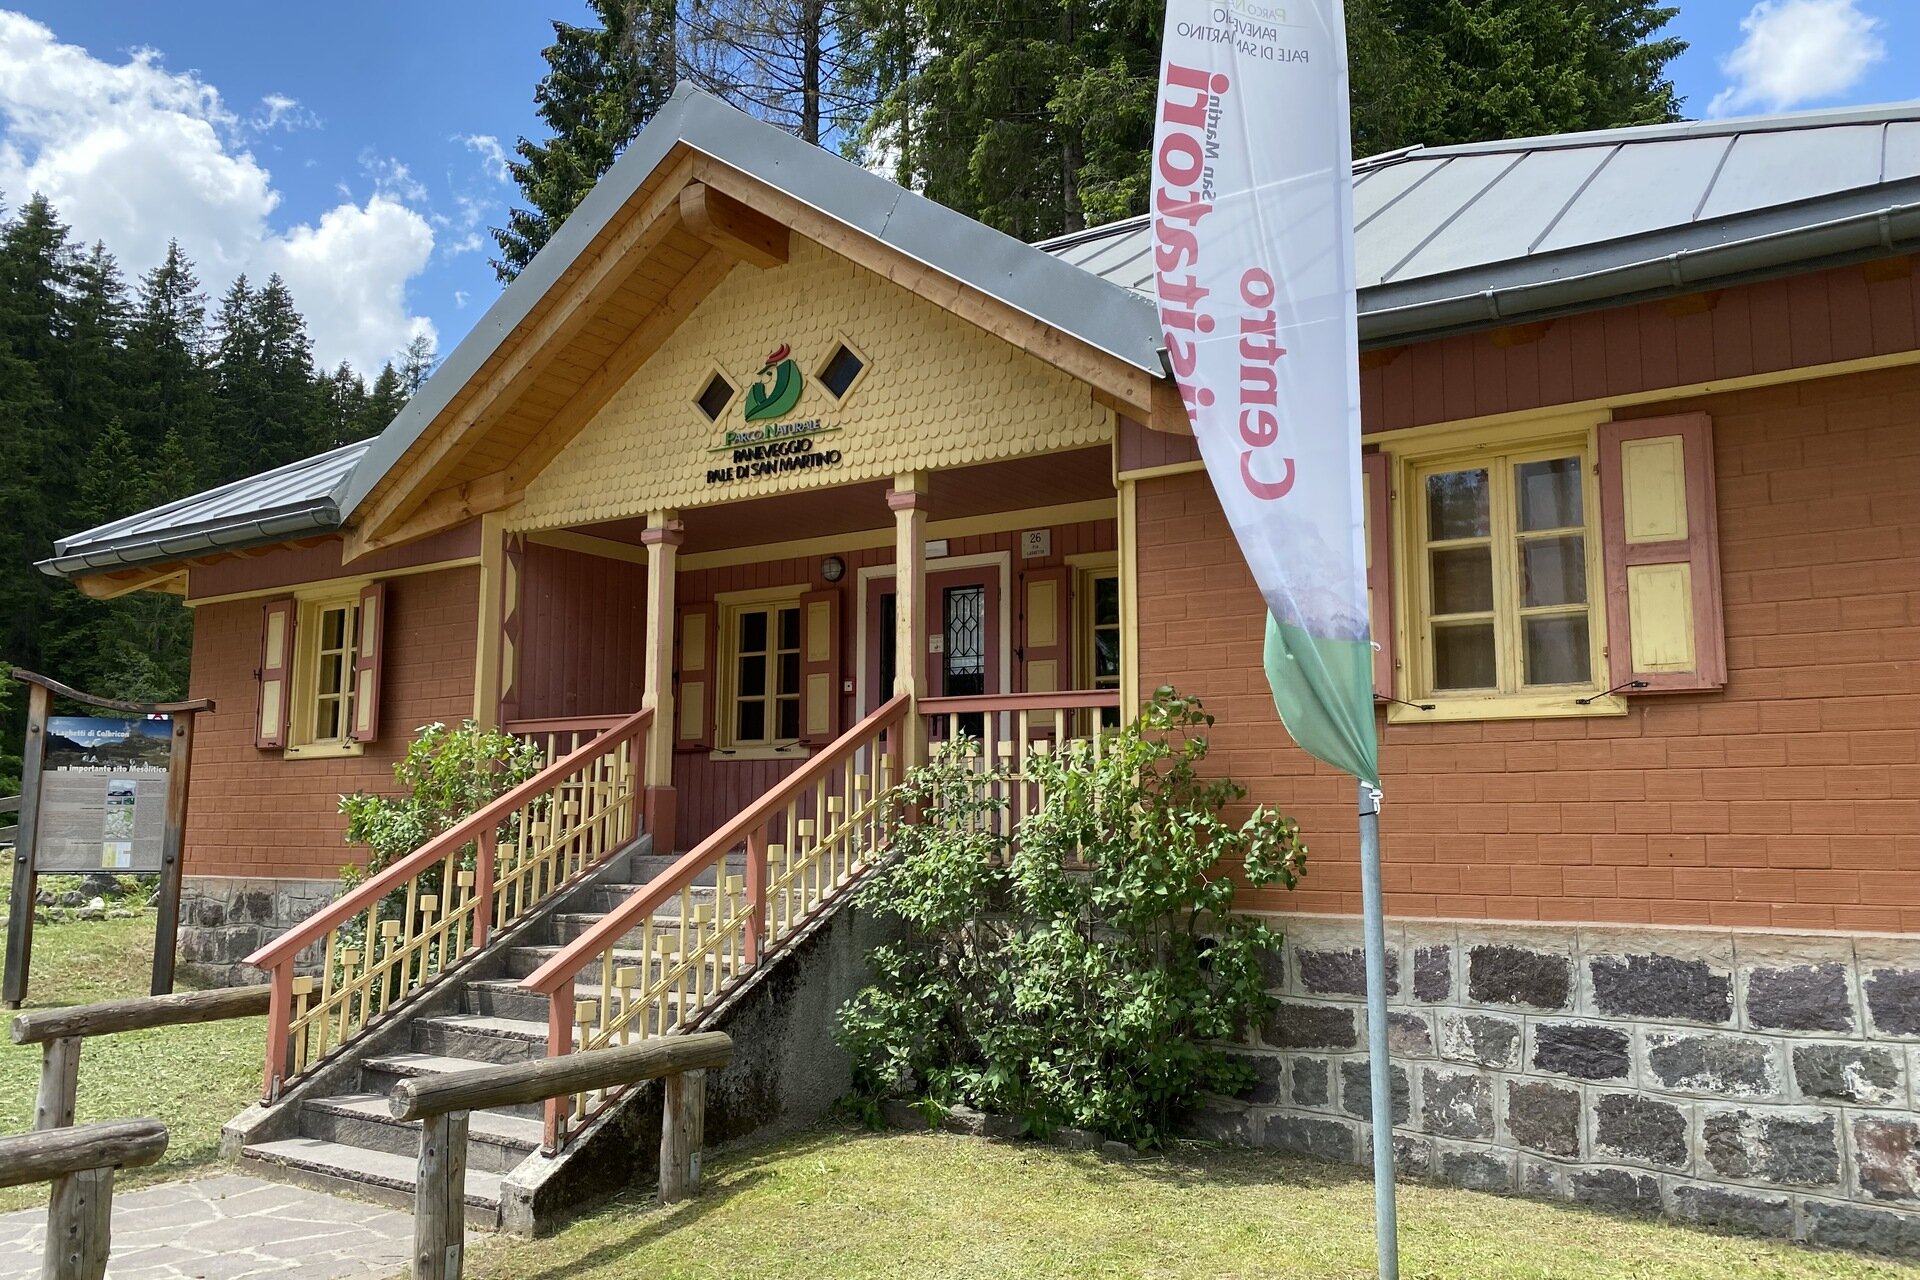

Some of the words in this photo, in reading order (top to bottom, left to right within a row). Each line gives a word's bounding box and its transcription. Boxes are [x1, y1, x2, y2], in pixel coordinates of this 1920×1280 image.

[733, 438, 813, 463] PANEVEGGIO
[706, 467, 734, 484] PALE
[736, 464, 749, 479] DI
[751, 459, 778, 476] SAN
[779, 449, 842, 472] MARTINO
[1030, 532, 1041, 543] 26
[87, 729, 95, 737] di
[69, 764, 111, 773] importante
[113, 765, 127, 773] sito
[129, 765, 167, 773] Mesolitico
